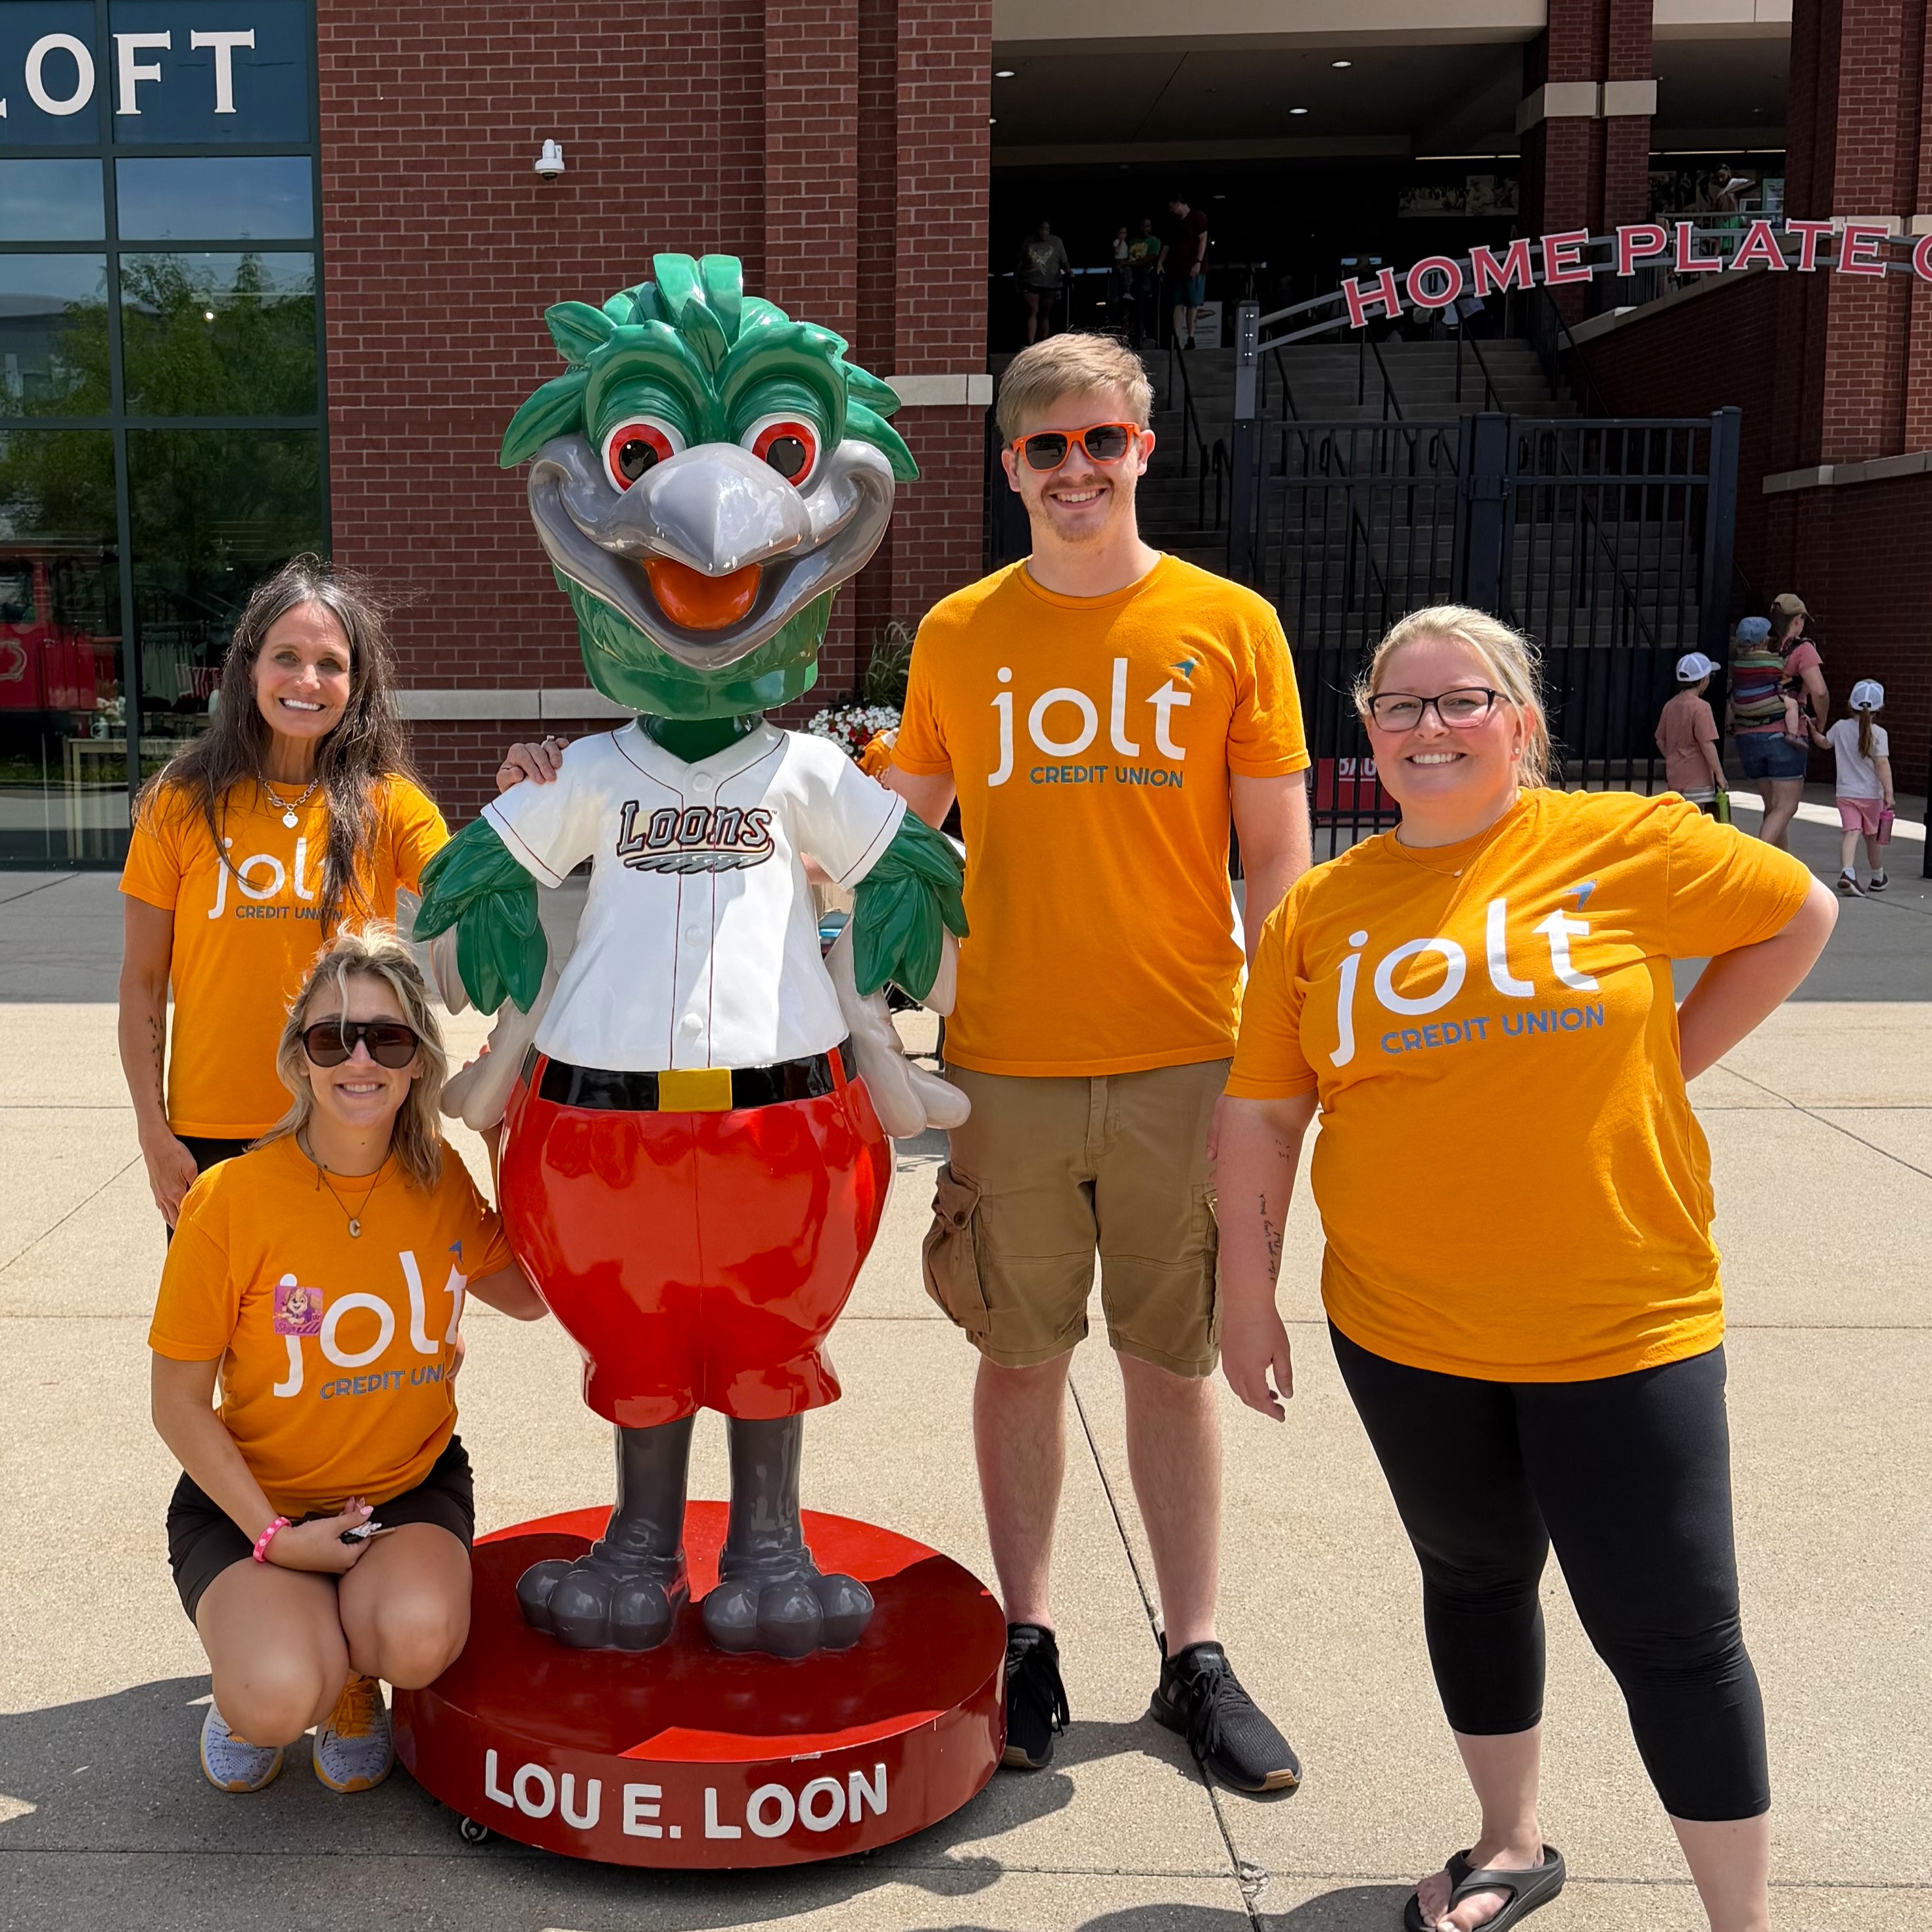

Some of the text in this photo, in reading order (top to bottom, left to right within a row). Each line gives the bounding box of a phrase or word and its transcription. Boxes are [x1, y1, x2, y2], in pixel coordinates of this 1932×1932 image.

[0, 29, 256, 119] OFT
[1340, 227, 1593, 329] HOME
[1616, 216, 1891, 278] PLATE
[987, 657, 1192, 787] jolt
[1029, 765, 1184, 788] CREDIT UNION
[616, 799, 773, 857] Loons
[208, 837, 343, 919] jol
[235, 905, 342, 920] CREDIT UNN
[1329, 897, 1600, 1068] jolt
[1381, 1002, 1604, 1054] CREDIT UNION
[320, 1363, 445, 1401] CREDIT UNI
[485, 1749, 887, 1839] LOU E. LOON
